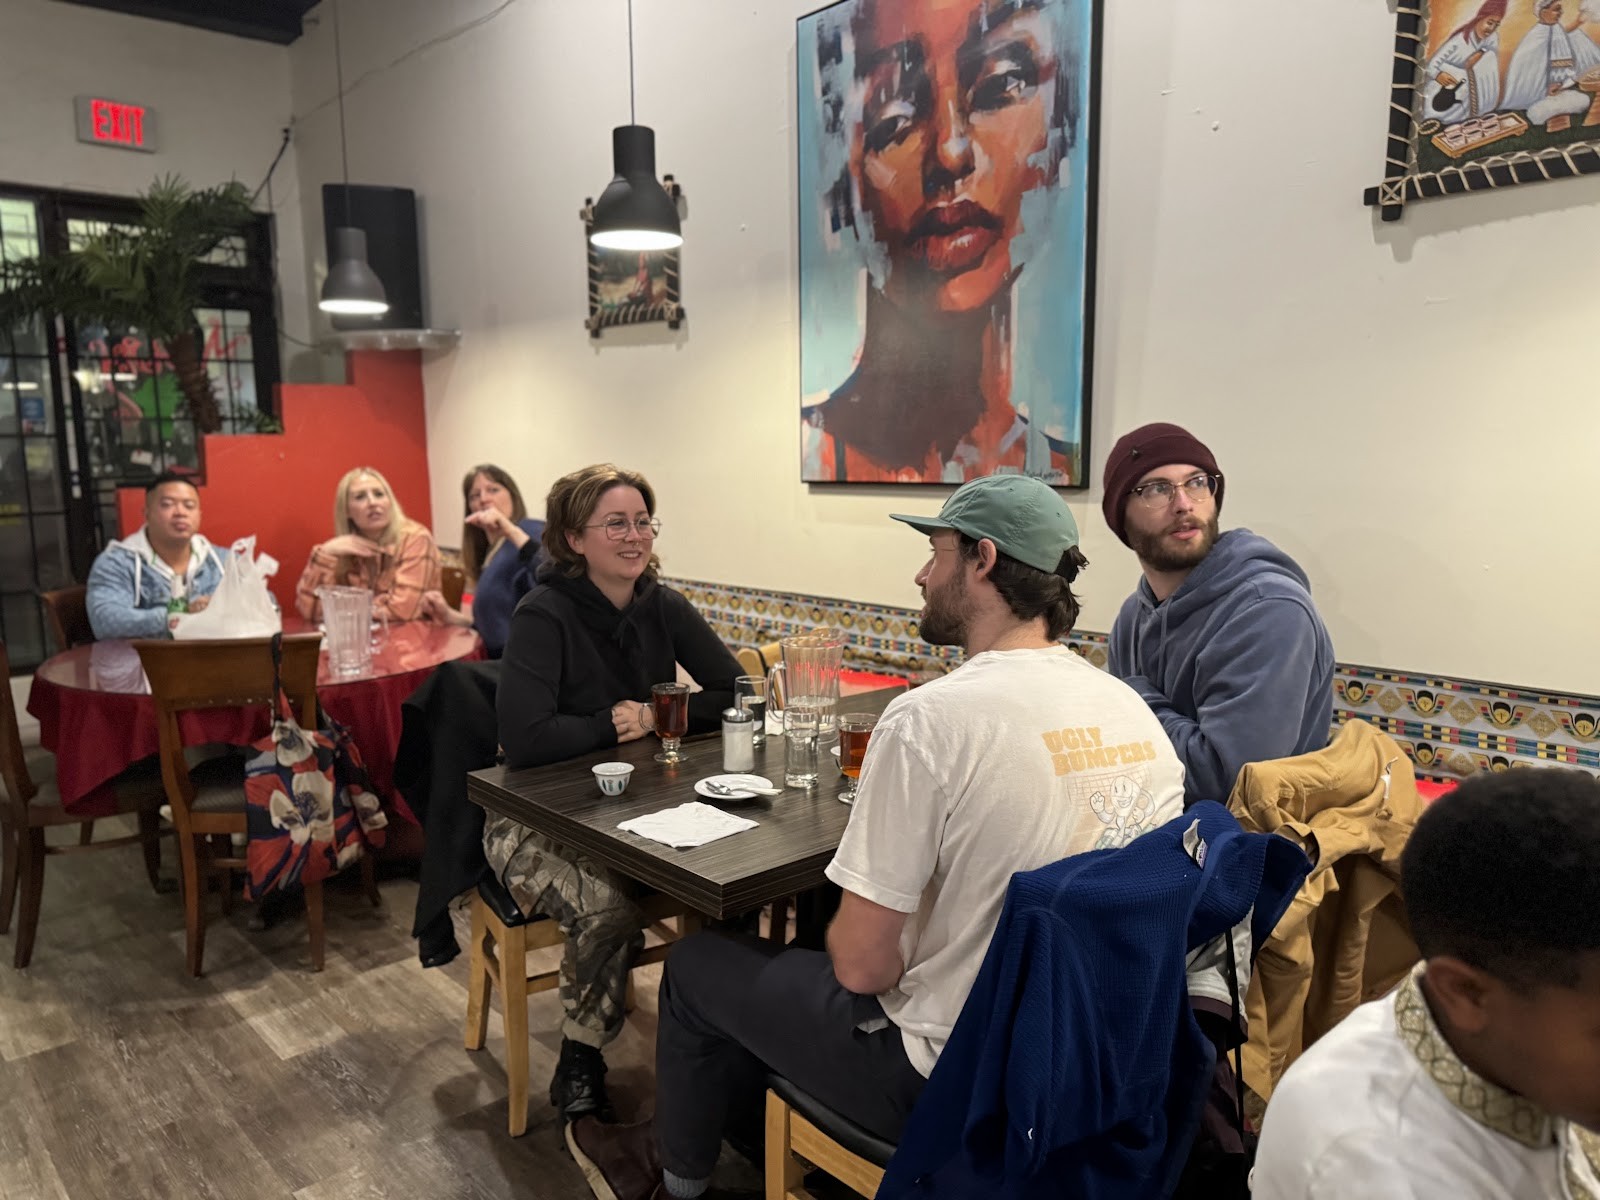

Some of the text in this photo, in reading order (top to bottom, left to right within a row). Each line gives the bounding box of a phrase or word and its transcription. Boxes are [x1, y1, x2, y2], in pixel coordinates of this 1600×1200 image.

[91, 98, 145, 146] EXIT
[1041, 726, 1103, 753] UGLY
[1051, 740, 1157, 776] BUMPERS
